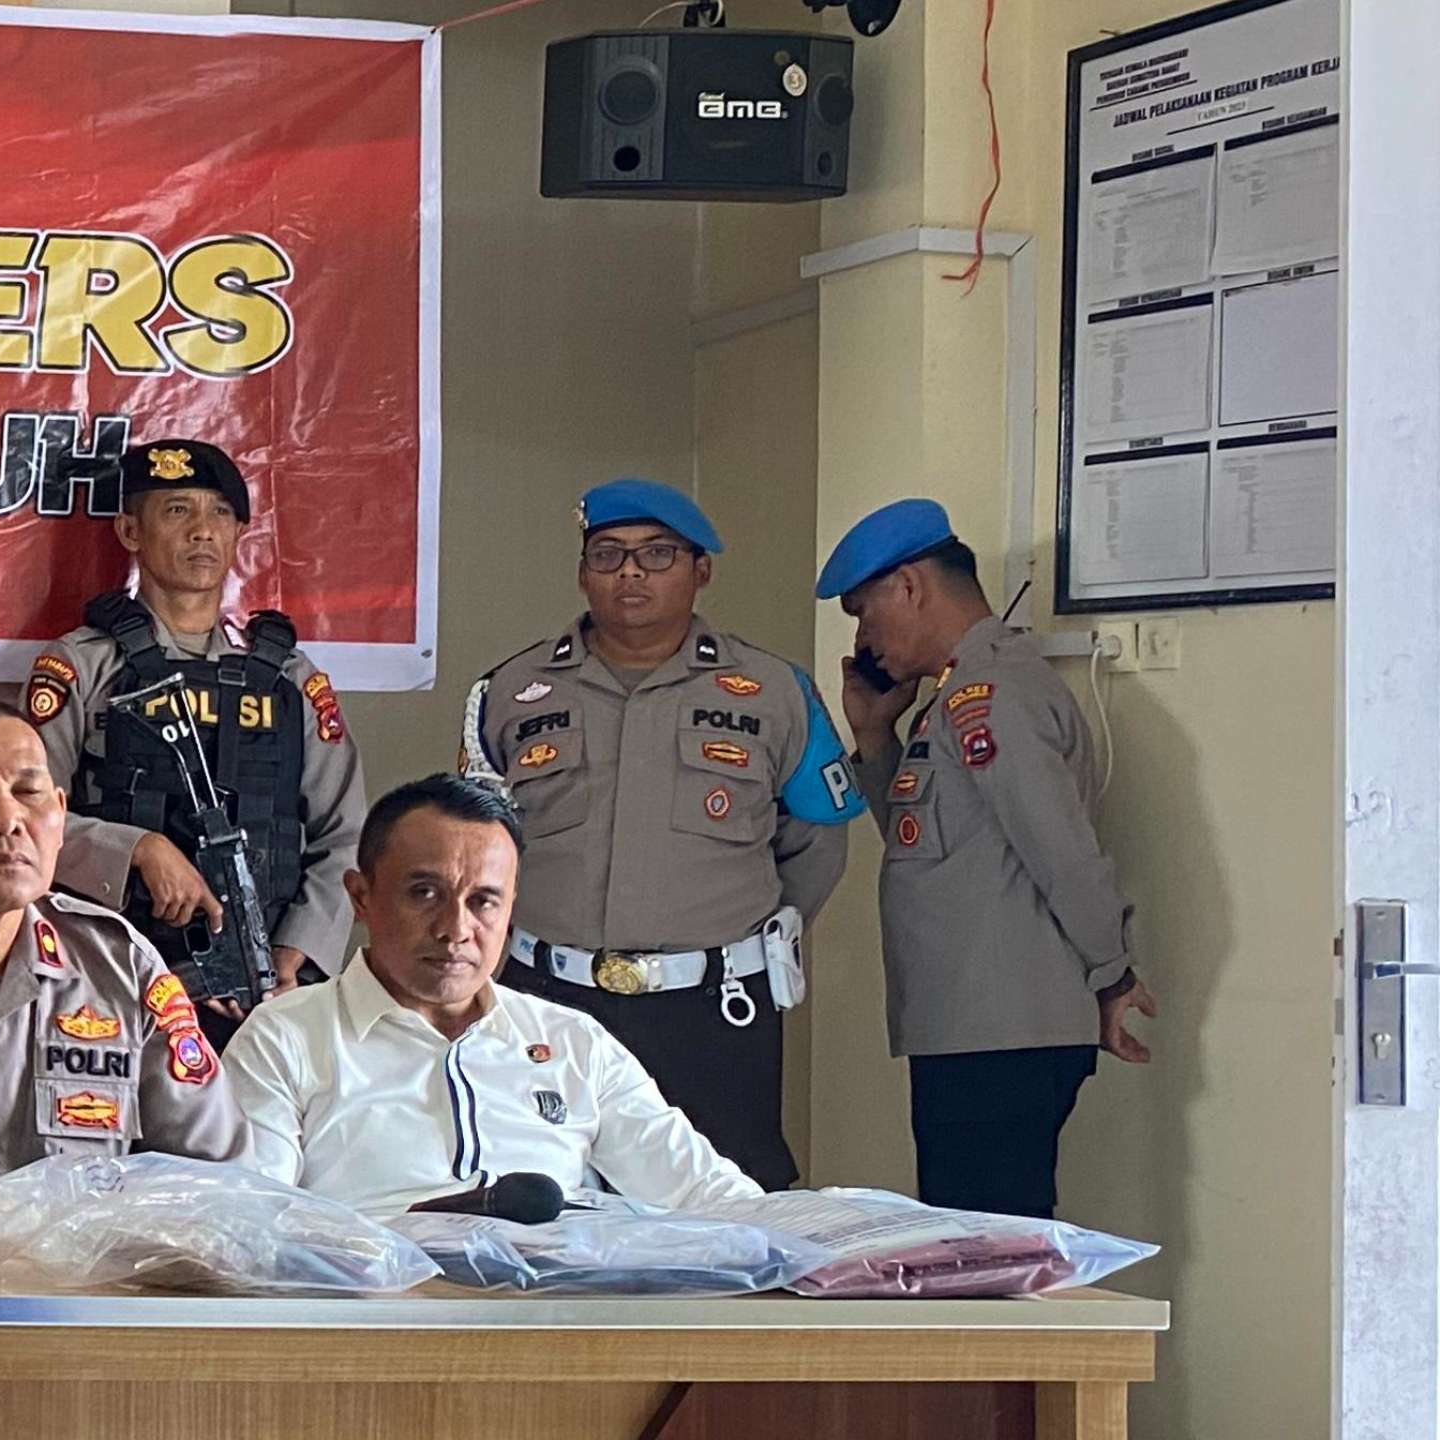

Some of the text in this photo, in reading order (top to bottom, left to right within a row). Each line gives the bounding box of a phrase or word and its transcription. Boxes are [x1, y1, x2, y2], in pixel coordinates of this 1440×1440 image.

[516, 710, 570, 741] JEFRI
[692, 709, 760, 735] POLRI
[46, 1045, 131, 1078] POLRI
